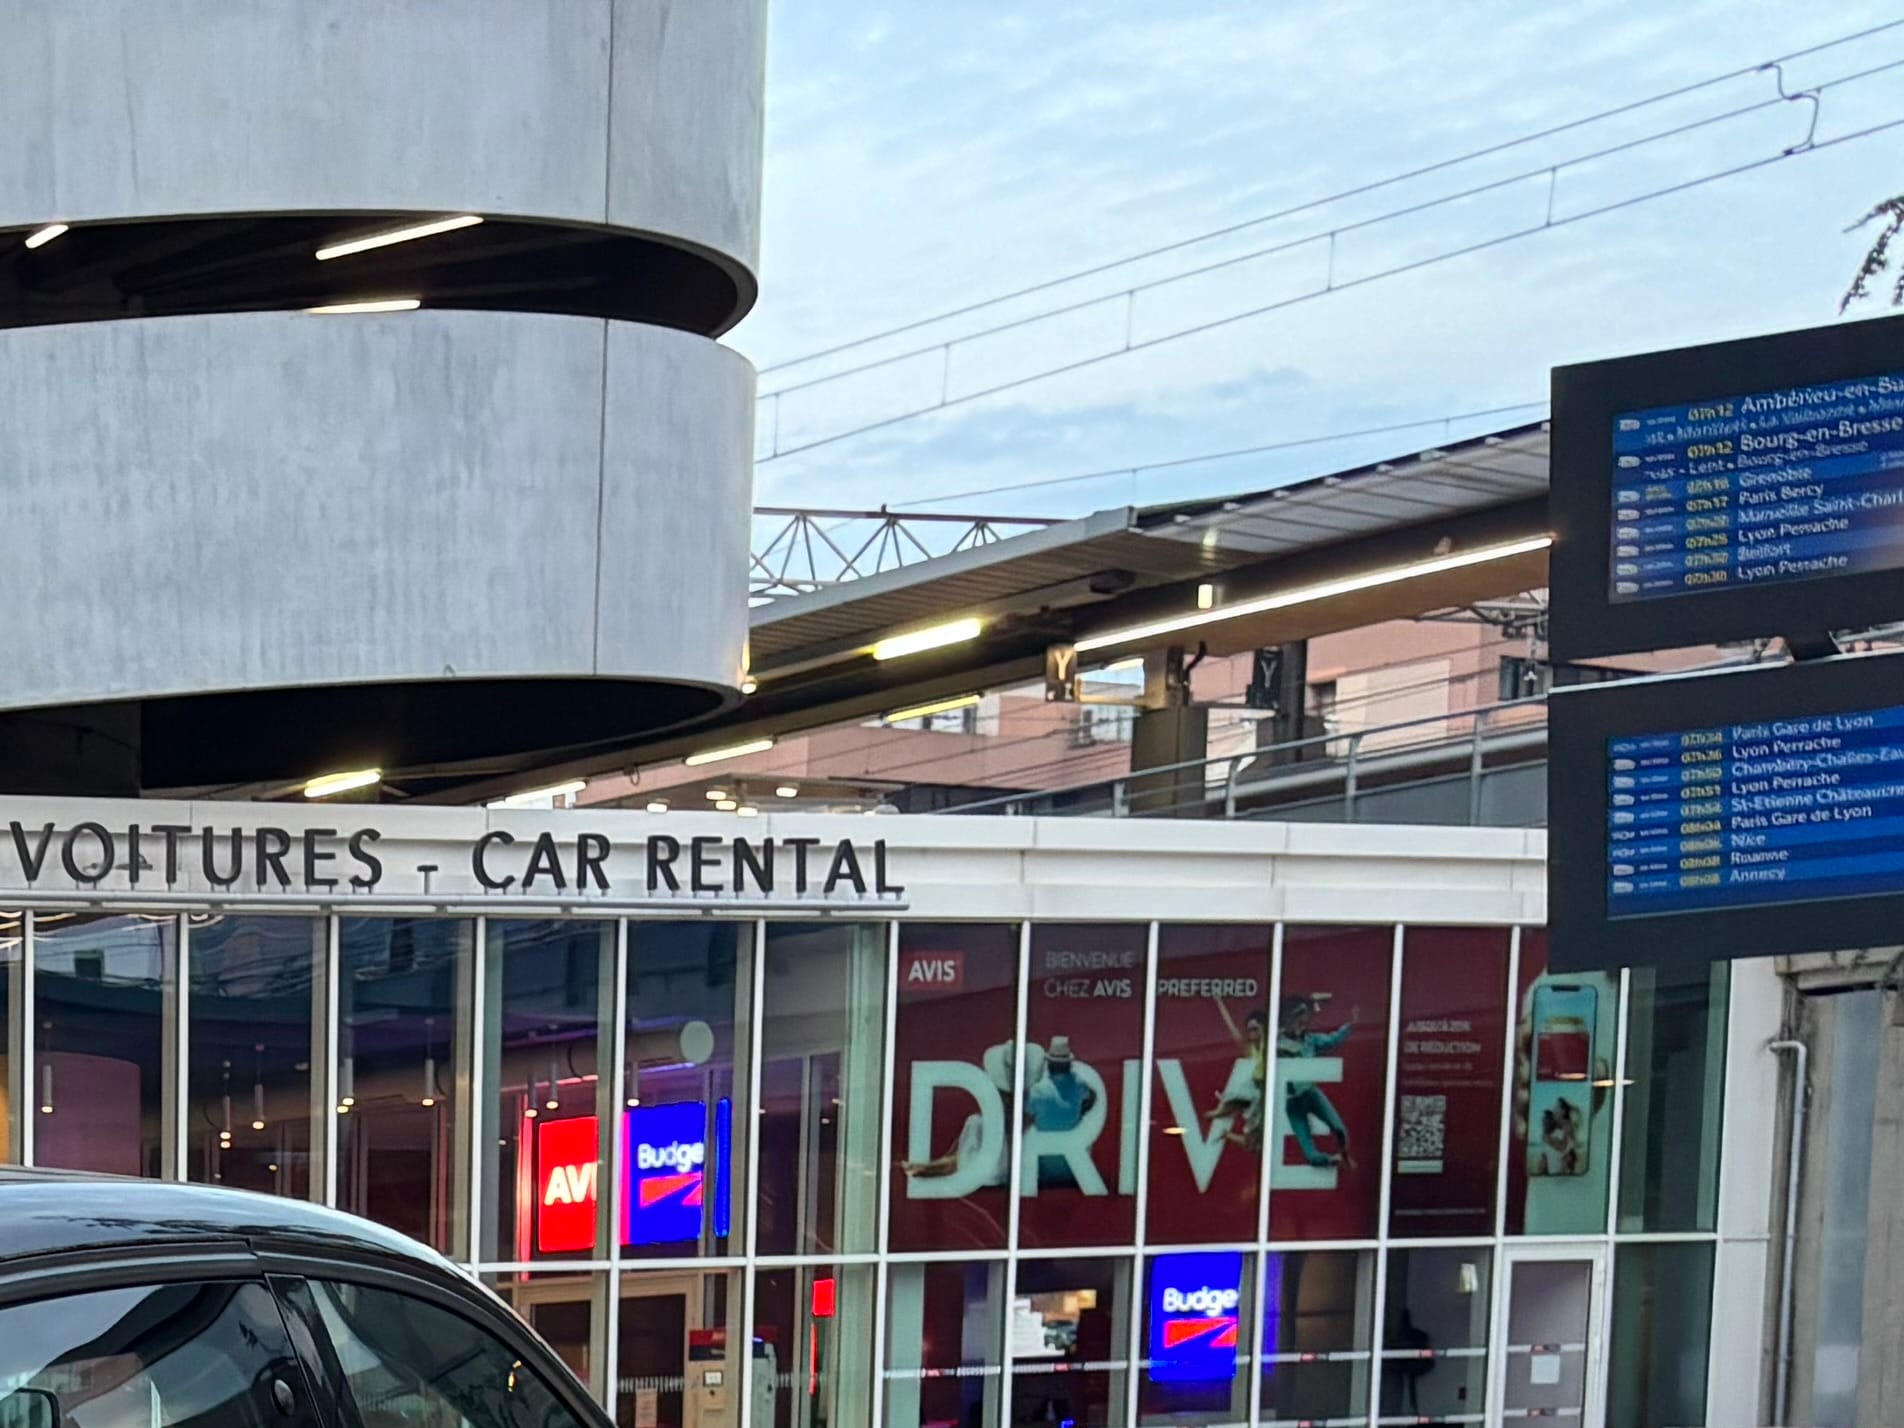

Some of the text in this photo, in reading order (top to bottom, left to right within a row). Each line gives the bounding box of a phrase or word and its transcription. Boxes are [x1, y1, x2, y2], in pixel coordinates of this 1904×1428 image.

[1741, 416, 1903, 451] Bourg-en-Bresse
[1772, 721, 1810, 737] Gare
[1812, 717, 1833, 732] de
[1836, 714, 1874, 732] Lyon
[1733, 743, 1769, 761] Lyon
[1773, 736, 1841, 754] Perrache
[1732, 779, 1769, 796] Lyon
[1773, 771, 1840, 789] Perrache
[1731, 813, 1768, 829] Paris
[1772, 811, 1808, 827] Gare
[1810, 807, 1832, 822] de
[1834, 804, 1872, 822] Lyon
[9, 820, 383, 889] VOITURES
[472, 831, 611, 891] CAR
[646, 836, 906, 894] RENTAL
[907, 960, 956, 982] AVIS
[1045, 951, 1134, 969] BIENVENUE
[1044, 978, 1257, 997] CHEZ AVIS PREFERRED
[907, 1057, 1343, 1199] DRIVE
[637, 1140, 705, 1173] Budge
[544, 1161, 598, 1206] AVI
[1163, 1286, 1238, 1317] Budge
